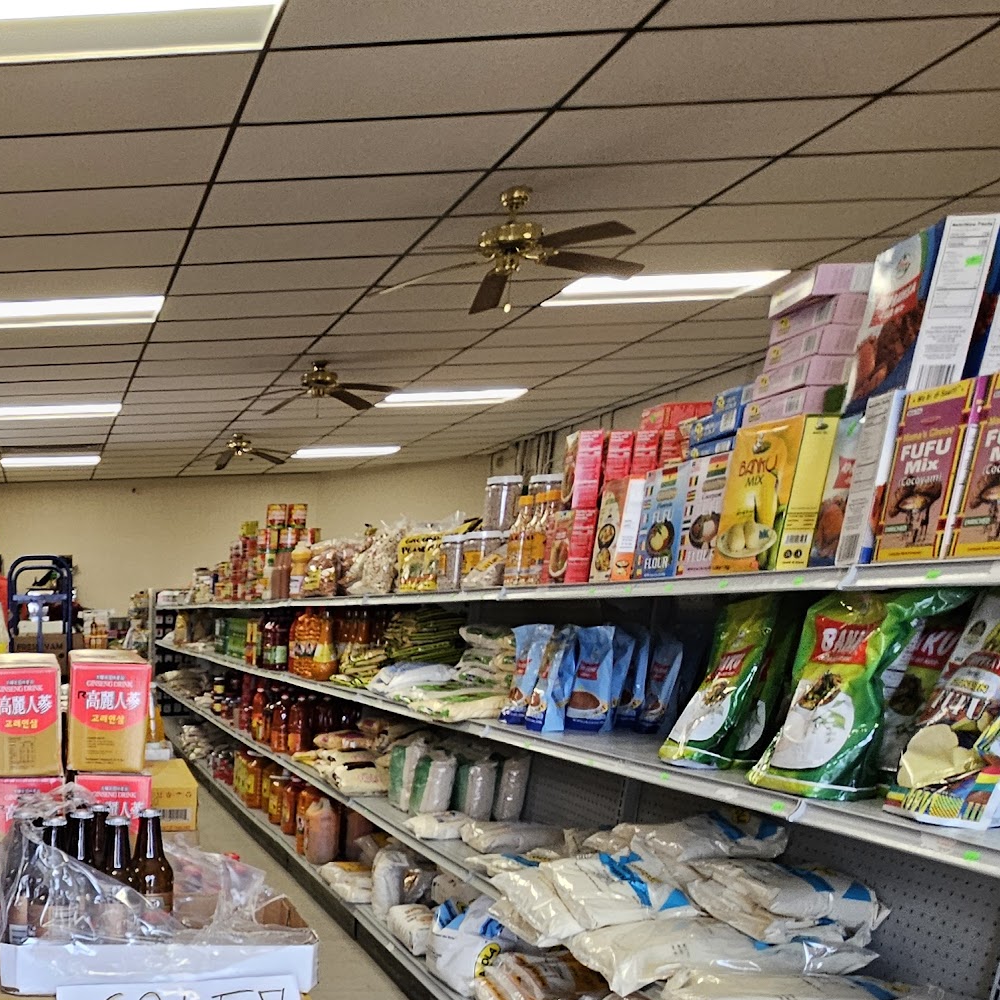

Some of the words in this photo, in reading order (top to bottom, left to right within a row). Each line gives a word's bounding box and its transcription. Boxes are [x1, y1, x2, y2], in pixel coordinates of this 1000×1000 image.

[900, 437, 952, 461] FUFU
[904, 458, 938, 475] Mix
[644, 556, 669, 570] FLOUR
